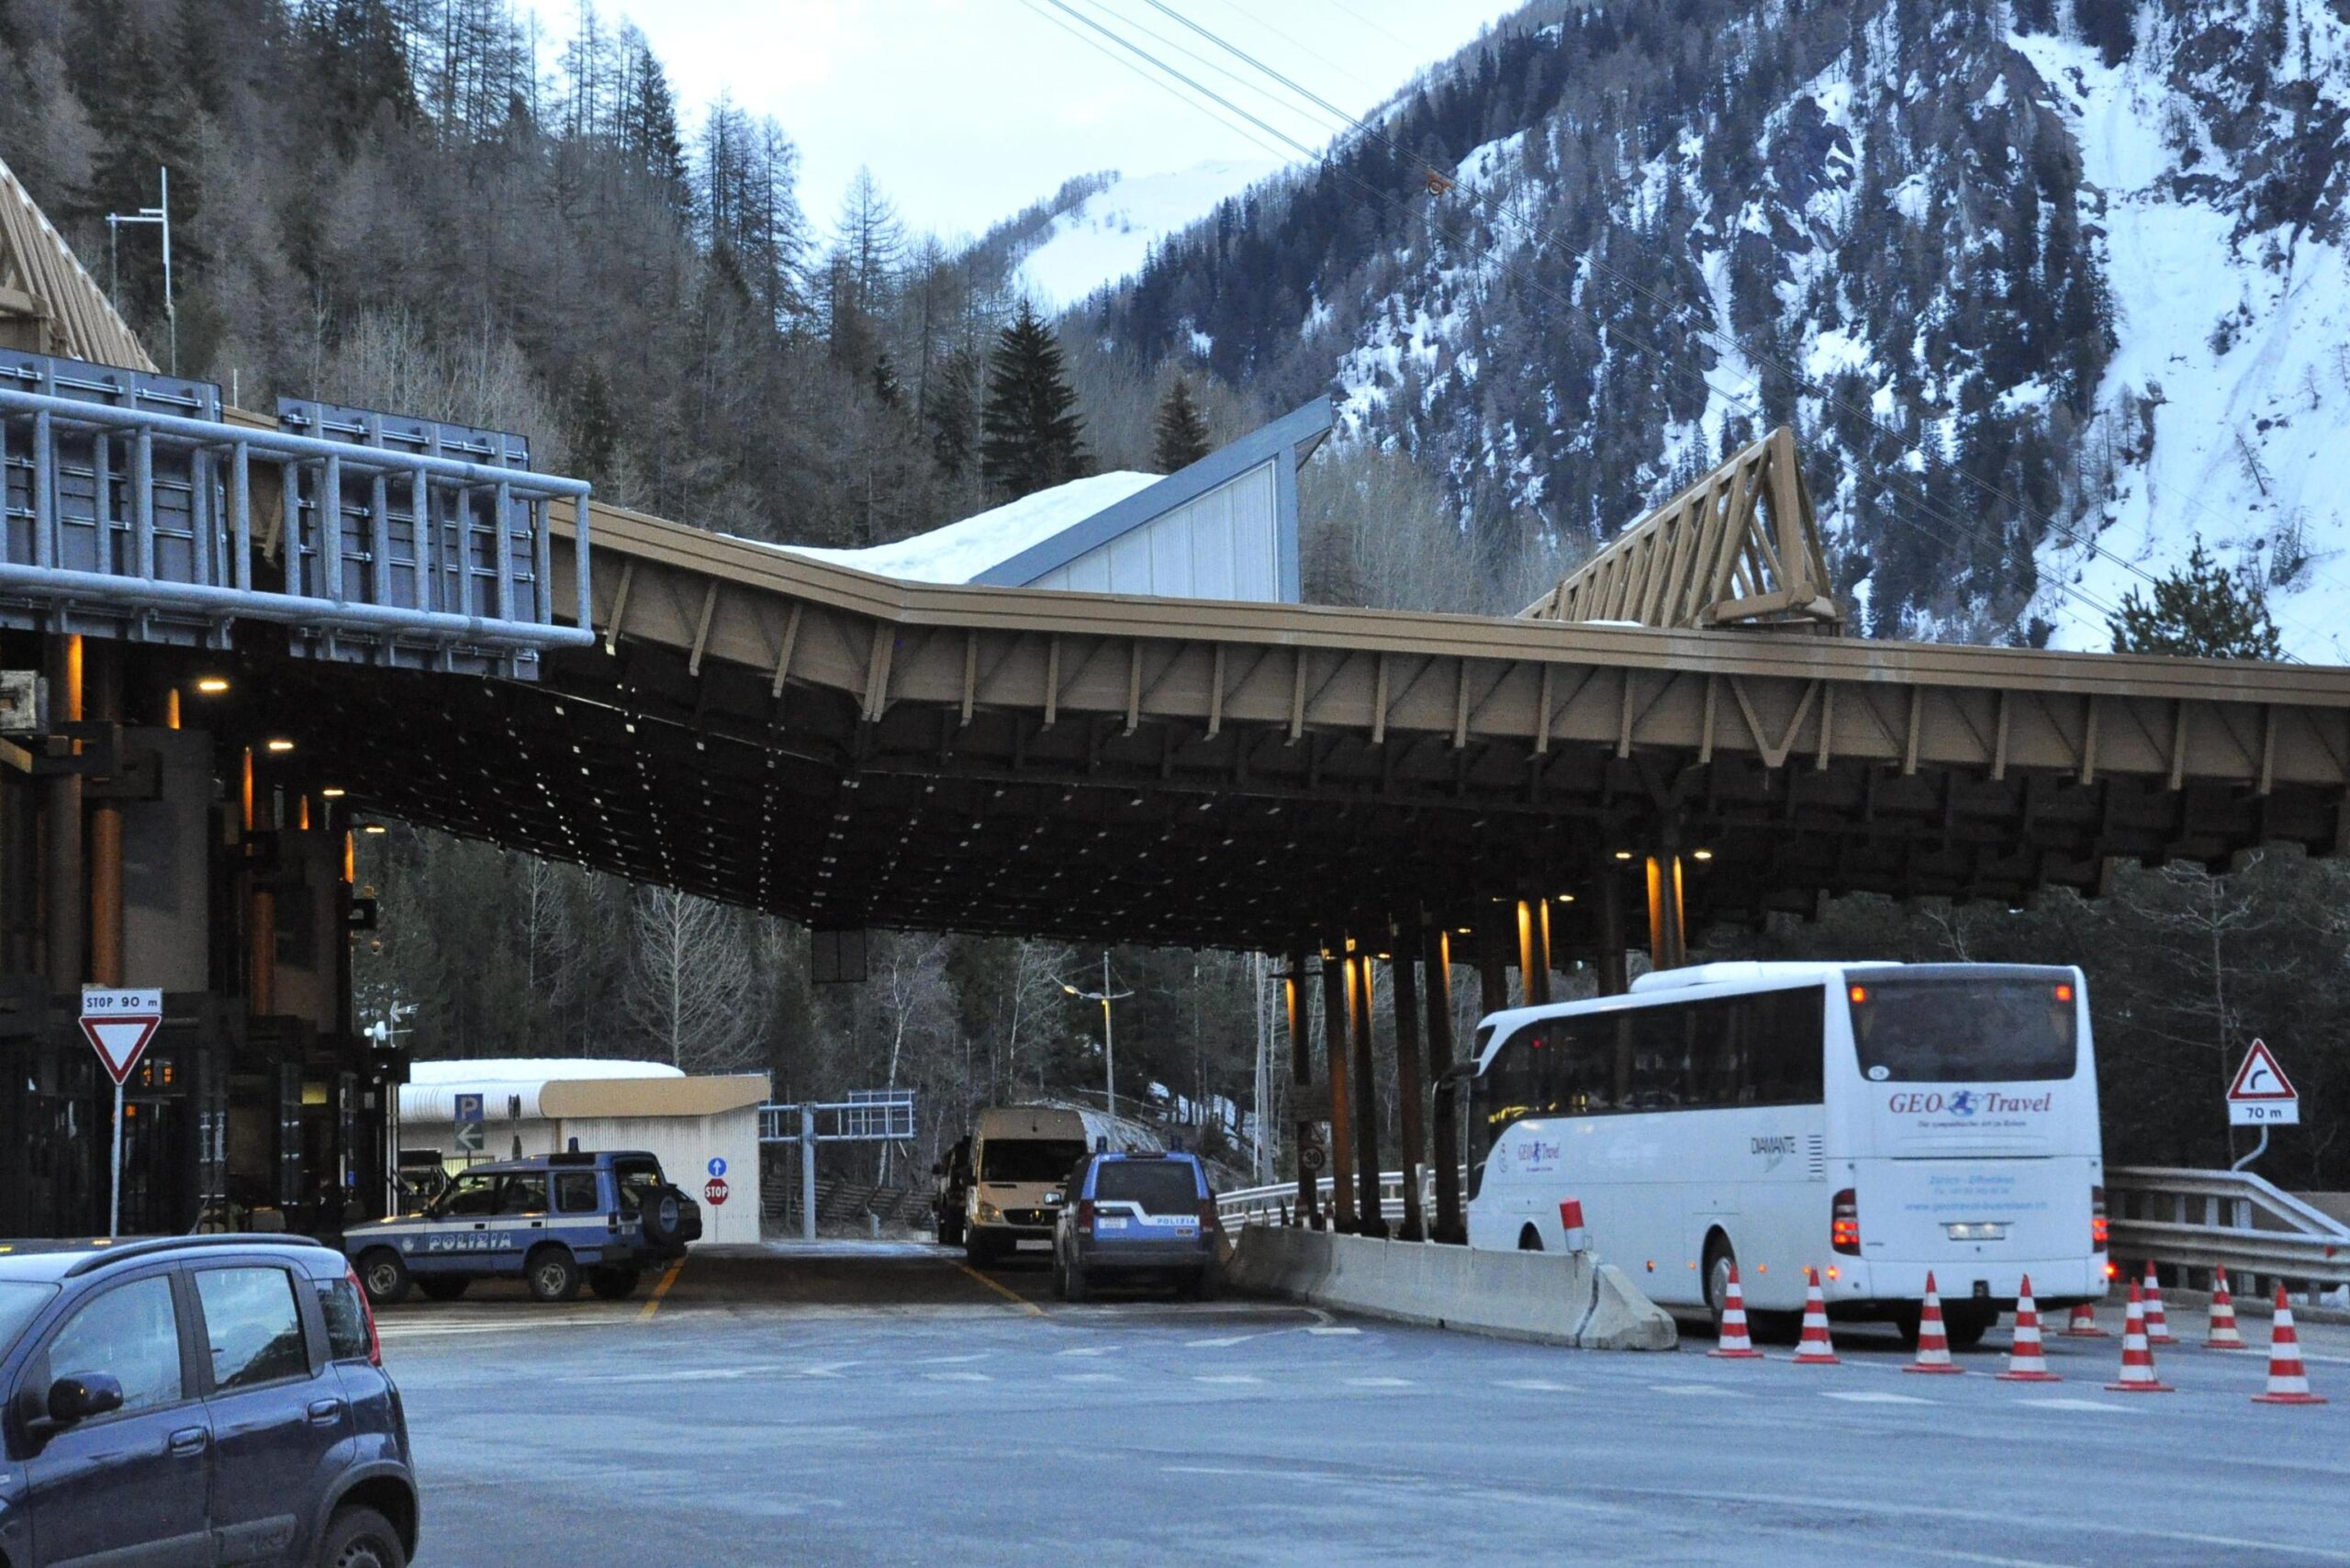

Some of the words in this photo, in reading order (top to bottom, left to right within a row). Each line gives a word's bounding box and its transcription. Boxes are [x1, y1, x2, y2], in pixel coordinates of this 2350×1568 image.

[86, 997, 114, 1008] STOP
[121, 996, 140, 1007] 90
[460, 1096, 478, 1119] P
[1889, 1092, 1943, 1114] GEO
[1986, 1092, 2053, 1113] Travel
[2245, 1107, 2264, 1119] 70
[2270, 1109, 2282, 1118] m
[1751, 1136, 1796, 1155] DIAMANTE
[1305, 1151, 1320, 1165] 30
[705, 1185, 728, 1199] STOP
[1157, 1217, 1196, 1226] POLIZIA
[429, 1231, 512, 1251] POLIZIA
